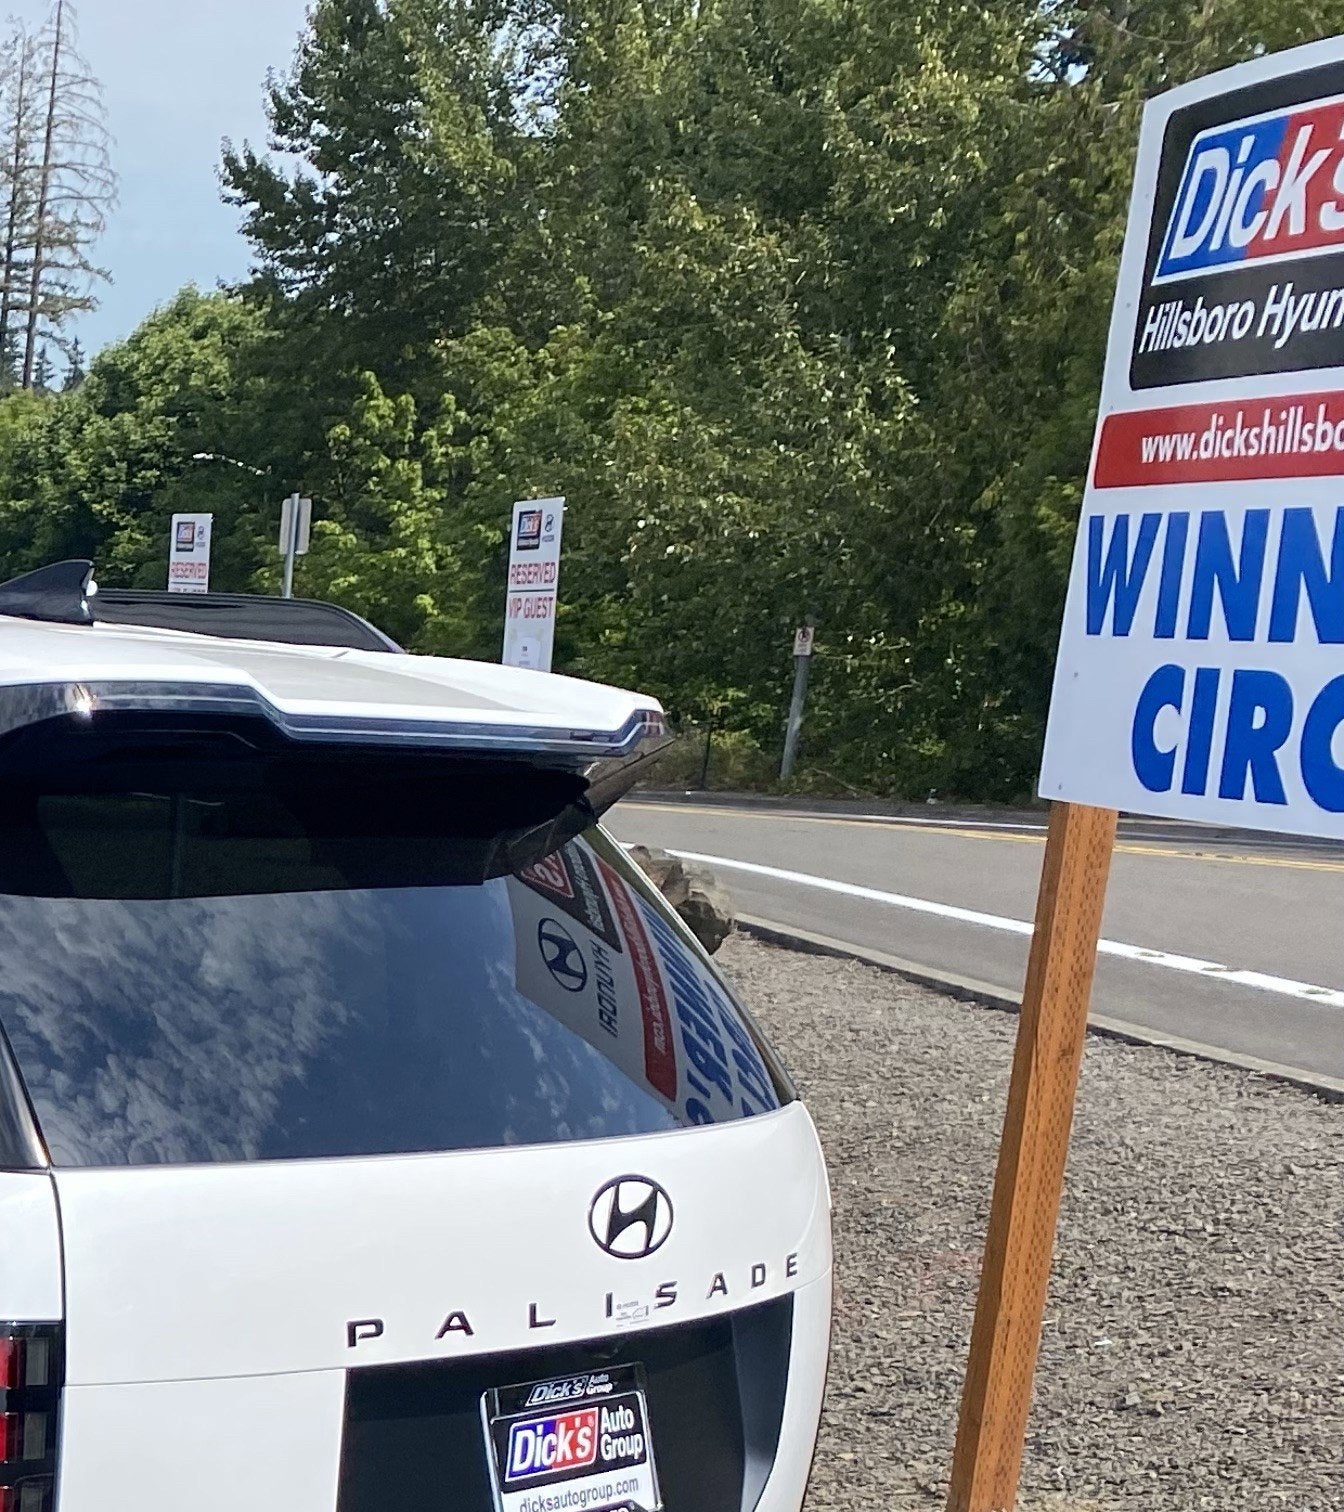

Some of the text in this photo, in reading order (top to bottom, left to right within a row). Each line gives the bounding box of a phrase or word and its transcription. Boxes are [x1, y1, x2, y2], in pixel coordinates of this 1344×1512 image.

[1168, 121, 1344, 260] Dick
[1139, 296, 1255, 354] Hillsboro
[509, 562, 555, 585] RESERVED
[1086, 507, 1344, 644] WINN
[509, 597, 553, 619] VIP GUEST
[346, 1253, 798, 1347] PALISADE
[530, 1373, 610, 1402] Dick's Auto
[586, 1382, 613, 1395] Group
[512, 1404, 635, 1472] Dick's Auto
[600, 1433, 644, 1461] Group
